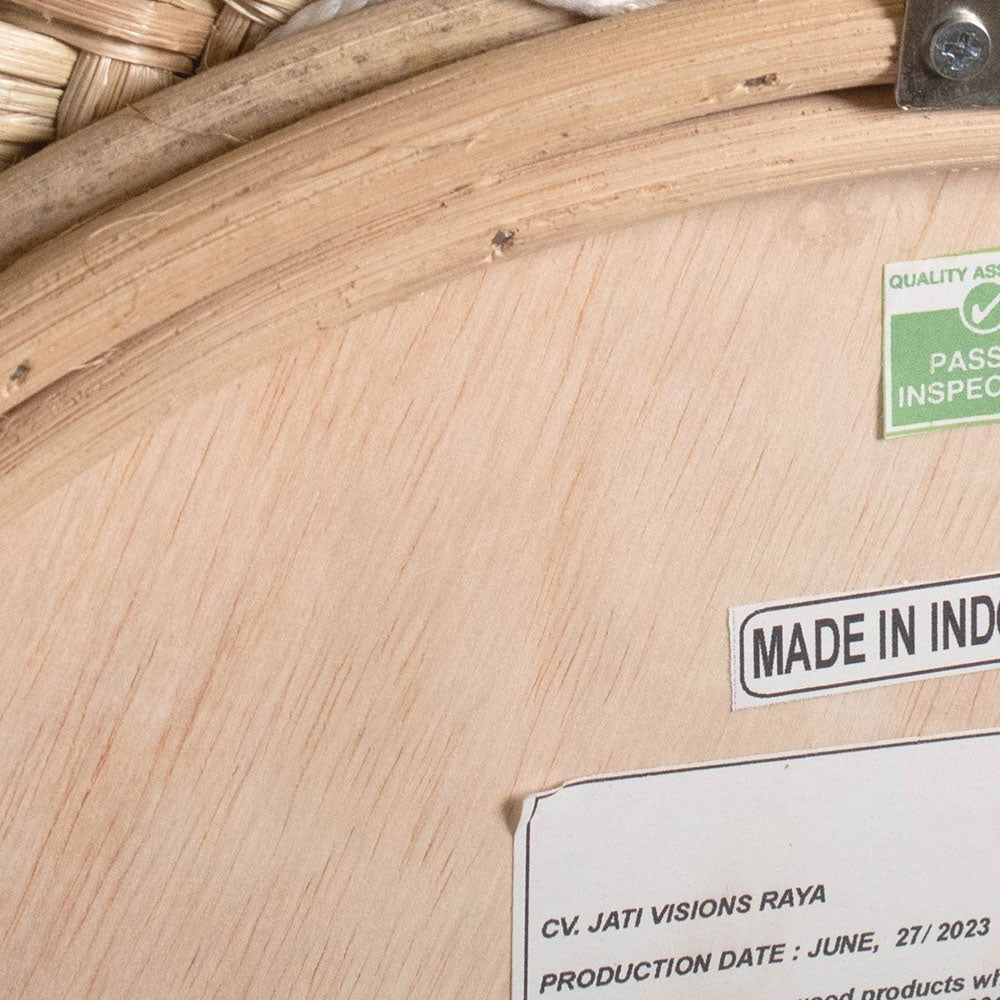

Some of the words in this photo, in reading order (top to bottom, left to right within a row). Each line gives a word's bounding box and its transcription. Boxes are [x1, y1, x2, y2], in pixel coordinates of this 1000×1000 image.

[889, 267, 968, 289] QUALITY
[752, 613, 865, 679] MADE
[879, 605, 915, 660] IN
[541, 915, 579, 938] CV.
[588, 908, 643, 933] JATI
[651, 894, 752, 924] VISIONS
[759, 884, 826, 911] RAYA
[539, 953, 711, 994] PRODUCTION
[718, 943, 786, 970] DATE
[807, 931, 879, 957] JUNE,
